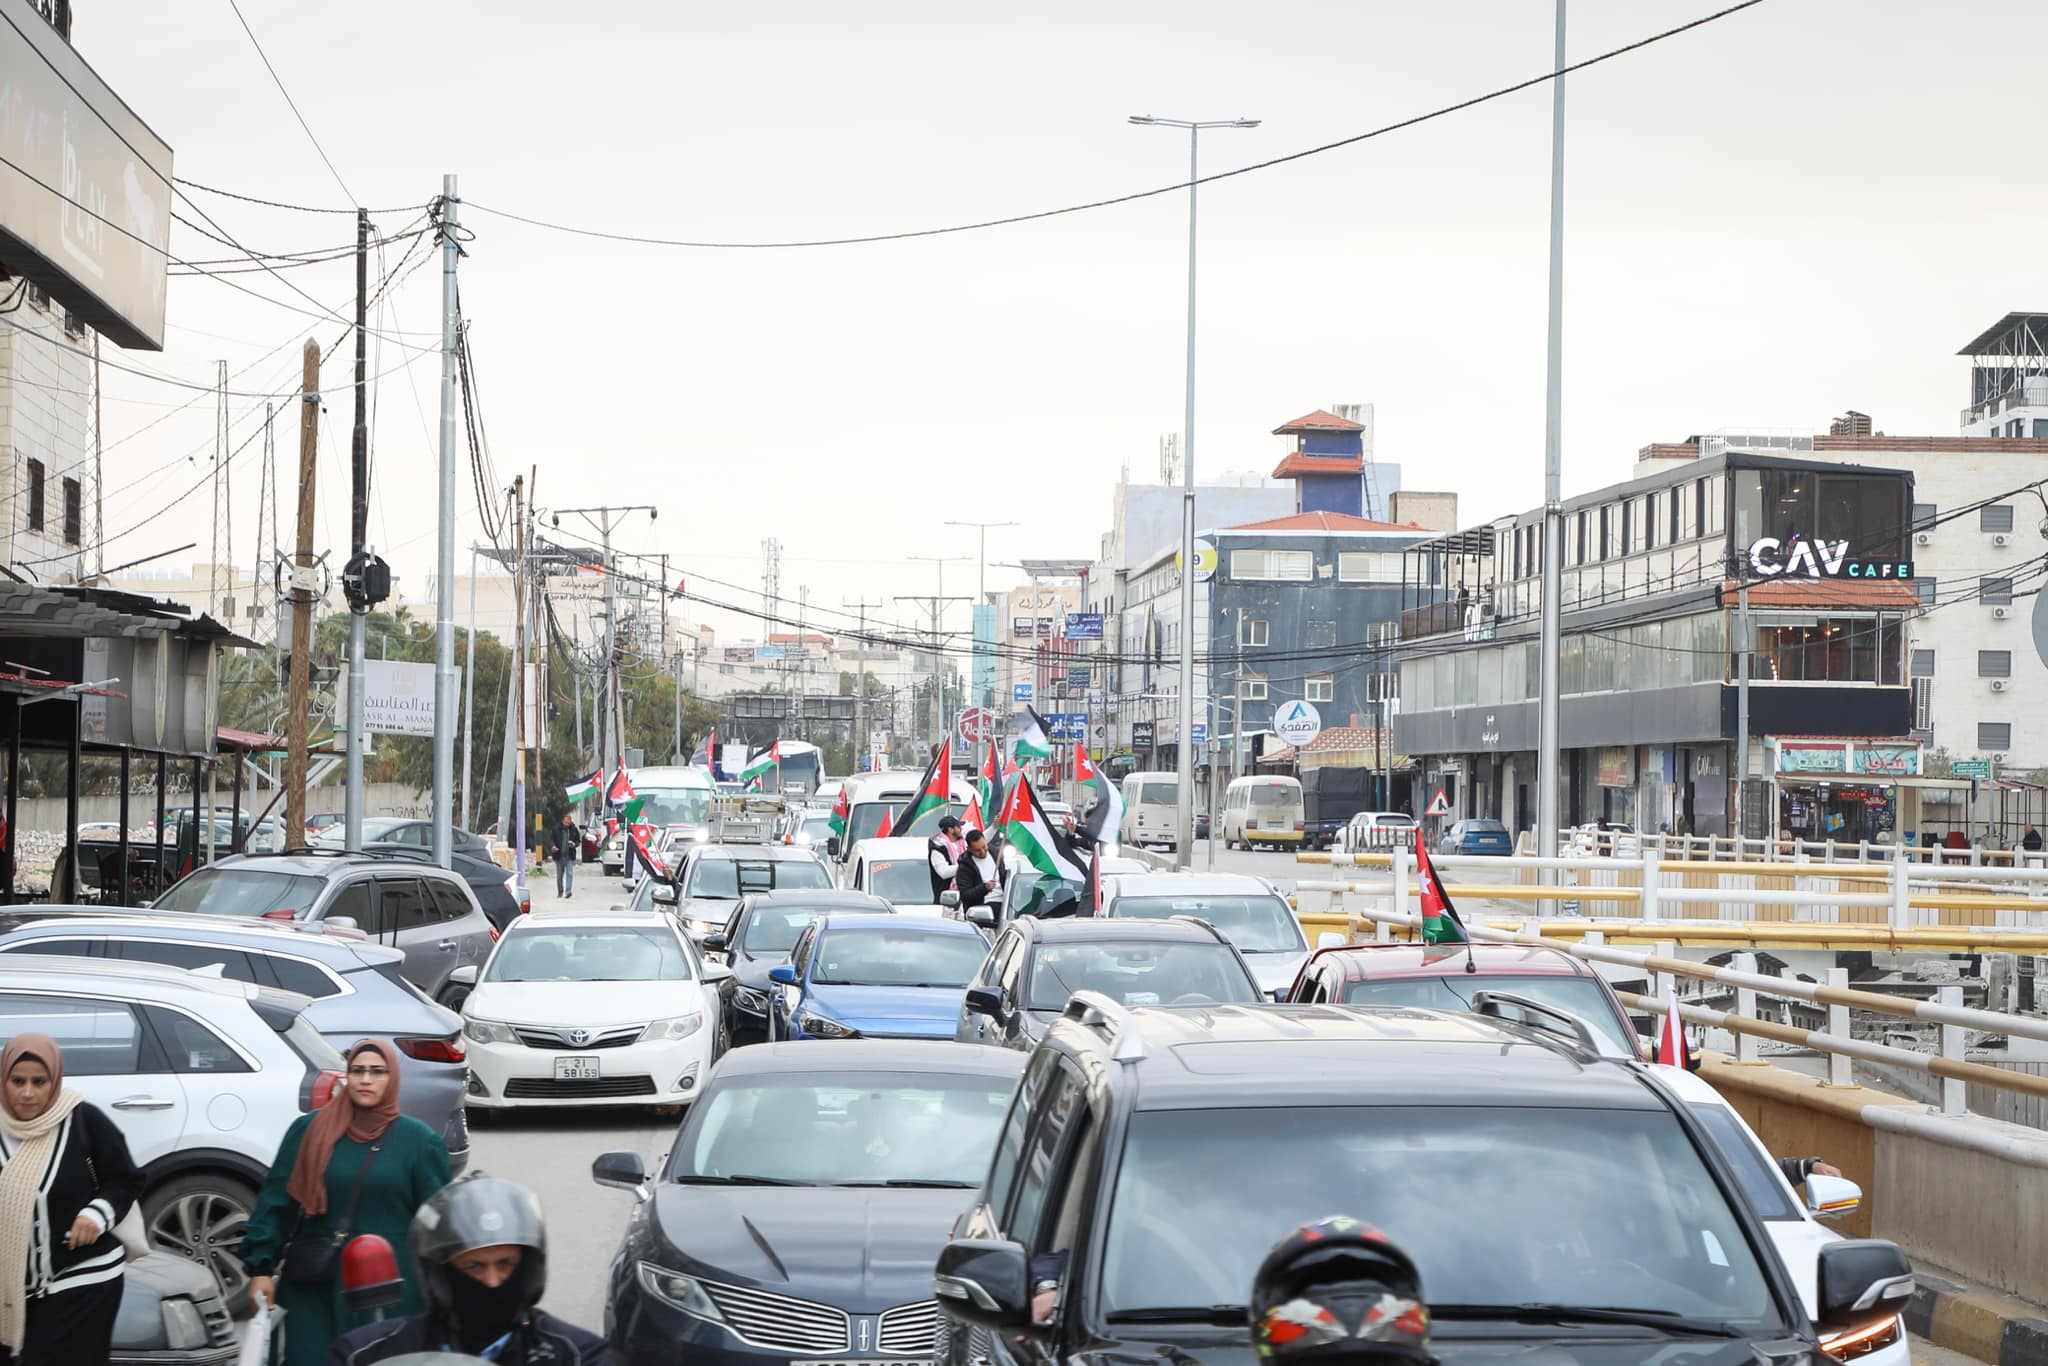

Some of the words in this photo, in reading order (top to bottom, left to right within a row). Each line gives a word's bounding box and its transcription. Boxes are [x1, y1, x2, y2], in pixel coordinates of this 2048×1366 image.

[1750, 537, 1849, 577] CAV
[1848, 564, 1908, 577] CAFE
[574, 1059, 586, 1068] 21
[564, 1069, 597, 1078] 58159
